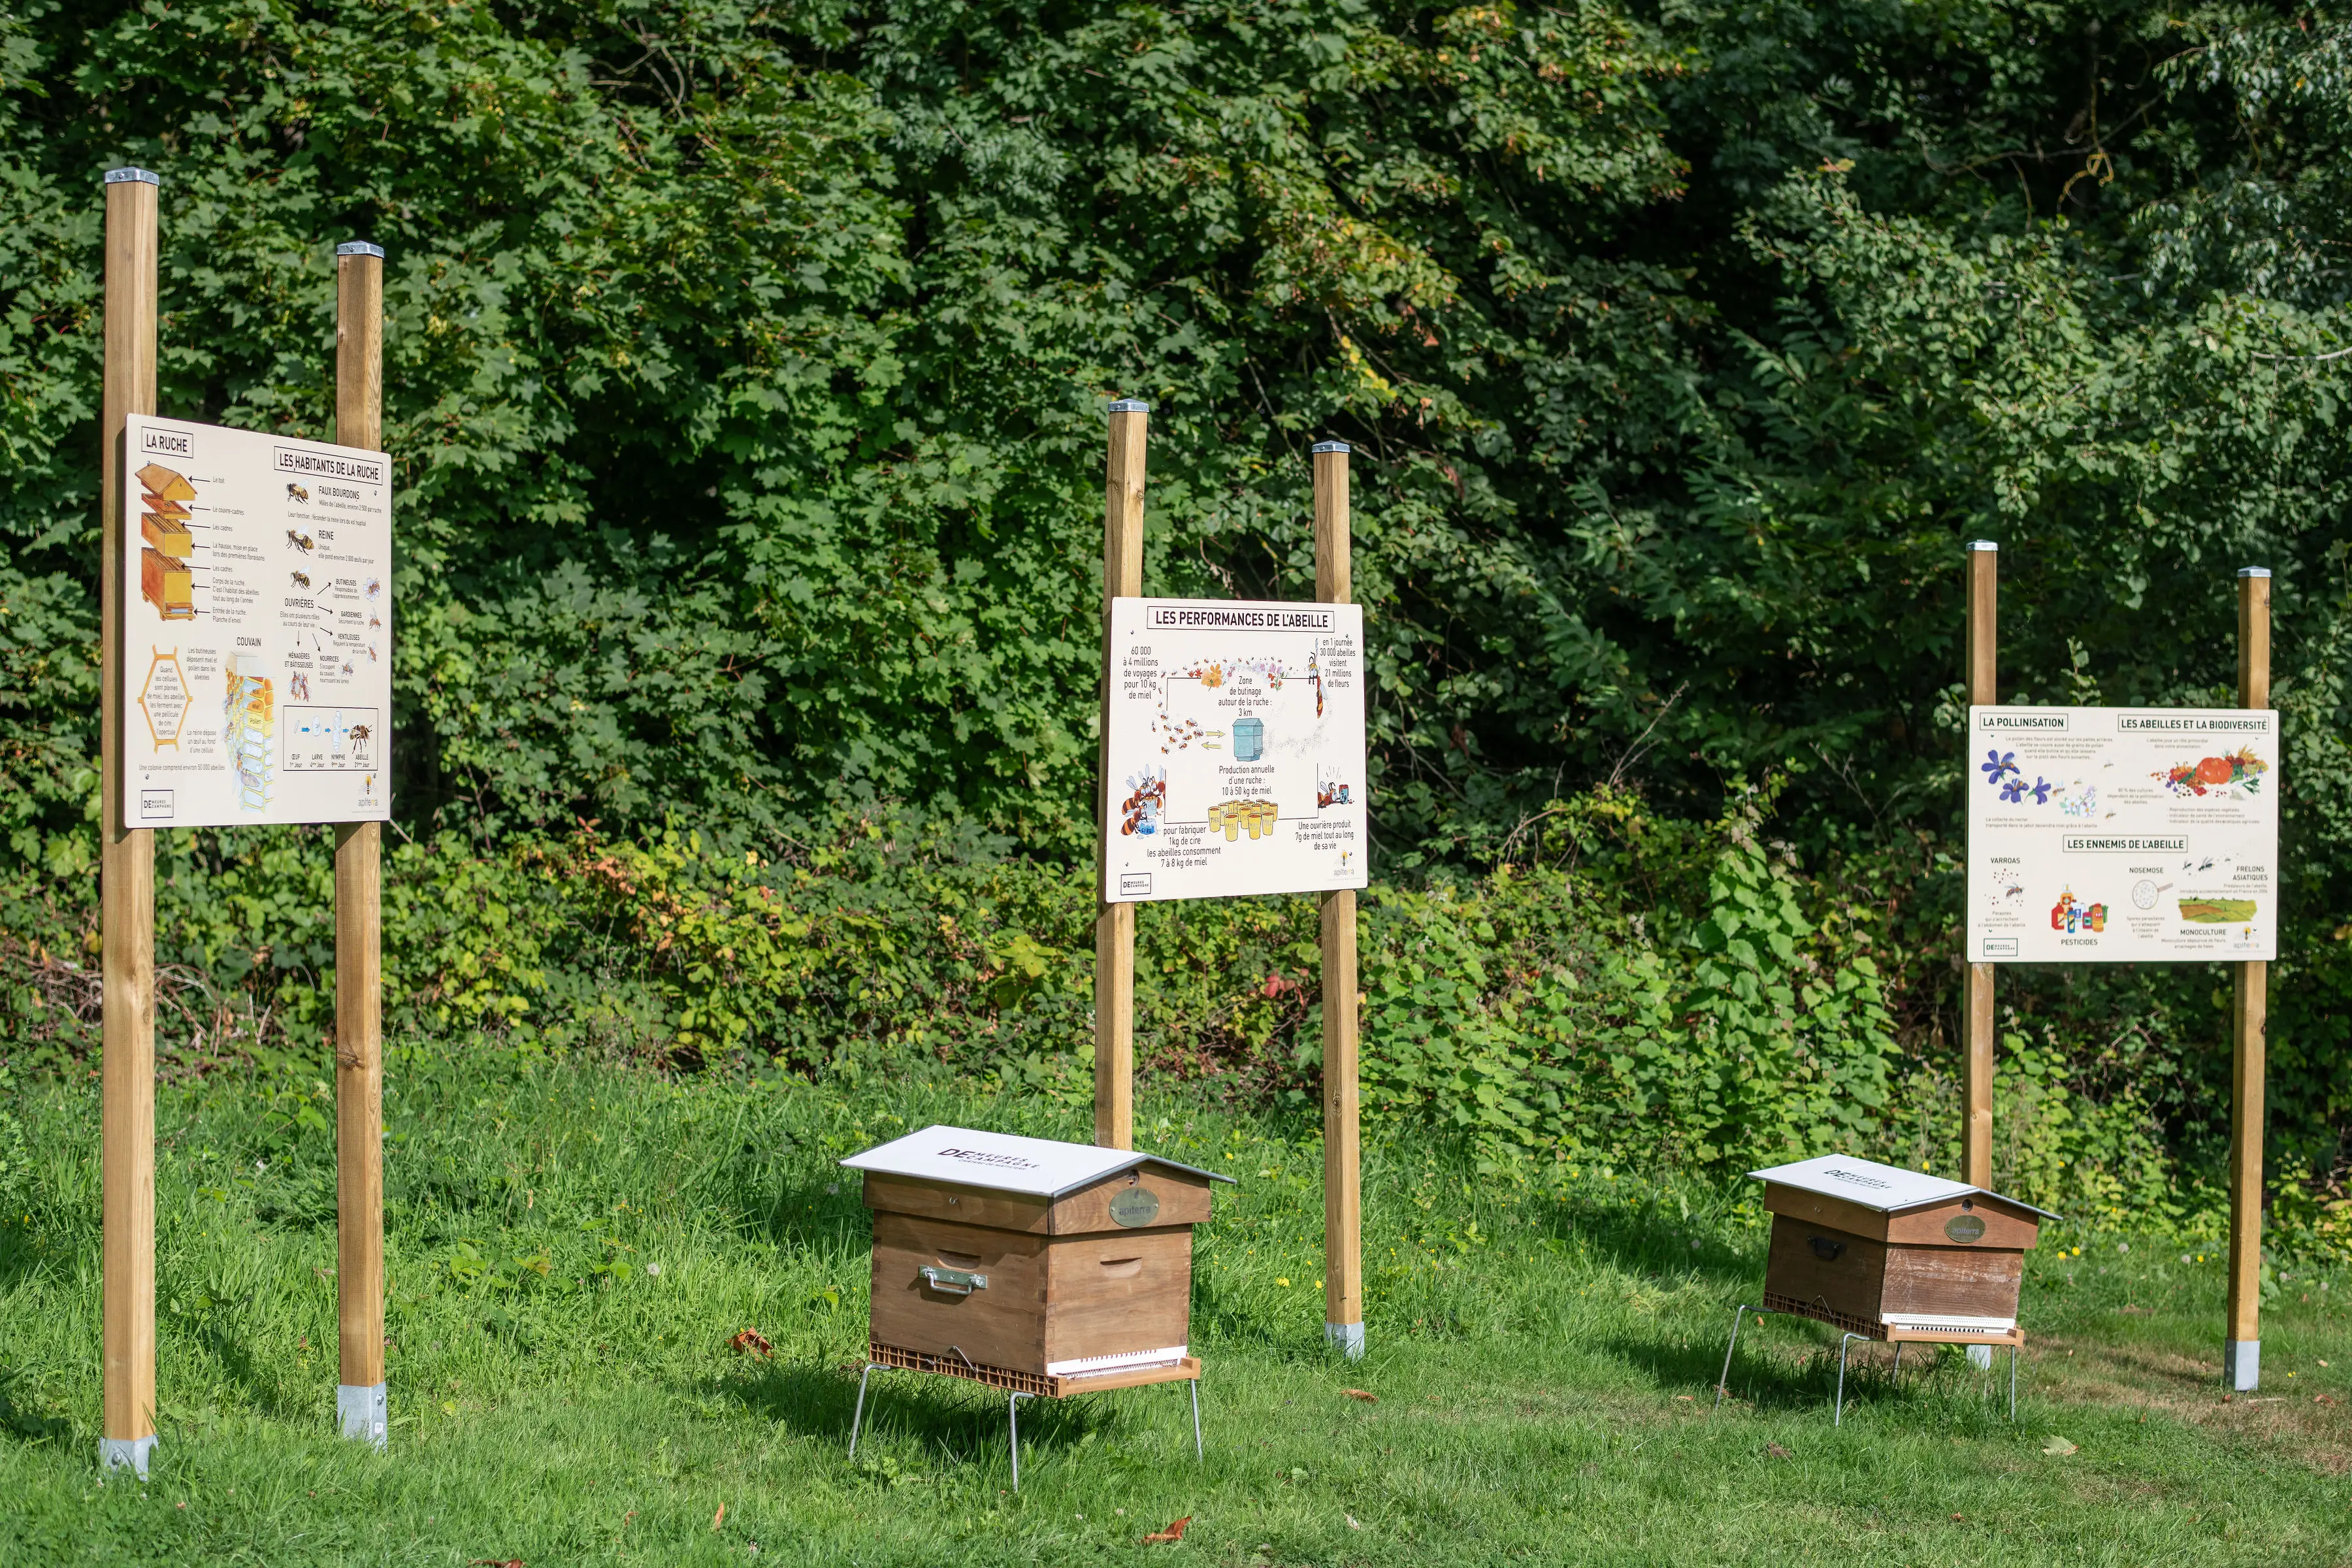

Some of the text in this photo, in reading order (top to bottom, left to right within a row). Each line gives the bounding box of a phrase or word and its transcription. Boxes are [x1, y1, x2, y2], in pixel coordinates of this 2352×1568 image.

[146, 434, 187, 452] LA RUCHE
[280, 453, 378, 480] LES HABITANTS DE LA RUCHE
[318, 485, 359, 499] FAUX BOURDONS
[318, 530, 333, 540] REINE
[285, 597, 314, 608] OUVRIÈRES
[1156, 611, 1328, 627] LES PERFORMANCES DE L'ABEILLE
[237, 637, 261, 646] COUVAIN
[1333, 637, 1352, 647] journée
[1131, 646, 1151, 655] 60 000
[1320, 647, 1326, 656] 30
[1327, 647, 1335, 656] 000
[1123, 657, 1158, 666] à 4 millions
[1124, 668, 1156, 680] de voyages
[1332, 668, 1351, 677] millions
[1124, 679, 1156, 690] pour 10 kg
[1239, 676, 1252, 684] Zone
[1335, 679, 1348, 687] fleurs
[1128, 690, 1151, 699] de miel
[1237, 687, 1261, 698] butinage
[1238, 708, 1252, 716] 3 km
[1983, 717, 2063, 727] LA POLLINISATION
[2121, 719, 2137, 728] LES
[2140, 719, 2180, 728] ABEILLES
[2183, 720, 2193, 728] ET
[2209, 720, 2266, 729] BIODIVERSITÉ
[1218, 764, 1274, 774] Production annuelle
[1245, 776, 1262, 784] ruche
[1222, 785, 1271, 796] 10 à 50 kg de miel
[358, 797, 378, 808] apiterra
[1298, 819, 1350, 830] Une ouvrière produit
[1163, 825, 1206, 837] pour fabriquer
[1295, 832, 1301, 842] 7g
[1311, 831, 1322, 840] miel
[1343, 830, 1354, 840] long
[1169, 836, 1201, 847] 1kg de cire
[1314, 841, 1320, 850] de
[2068, 840, 2183, 849] LES ENNEMIS DE L'ABEILLE
[1147, 847, 1220, 857] les abeilles consomment
[1160, 858, 1164, 867] 7
[1166, 858, 1169, 867] à
[1171, 858, 1175, 867] 8
[1177, 858, 1183, 868] kg
[1194, 857, 1207, 865] miel
[966, 1155, 1041, 1168] CAMPAGNE
[973, 1152, 1028, 1162] MEURES
[1119, 1205, 1151, 1218] apiterra
[1952, 1227, 1980, 1235] apiterra
